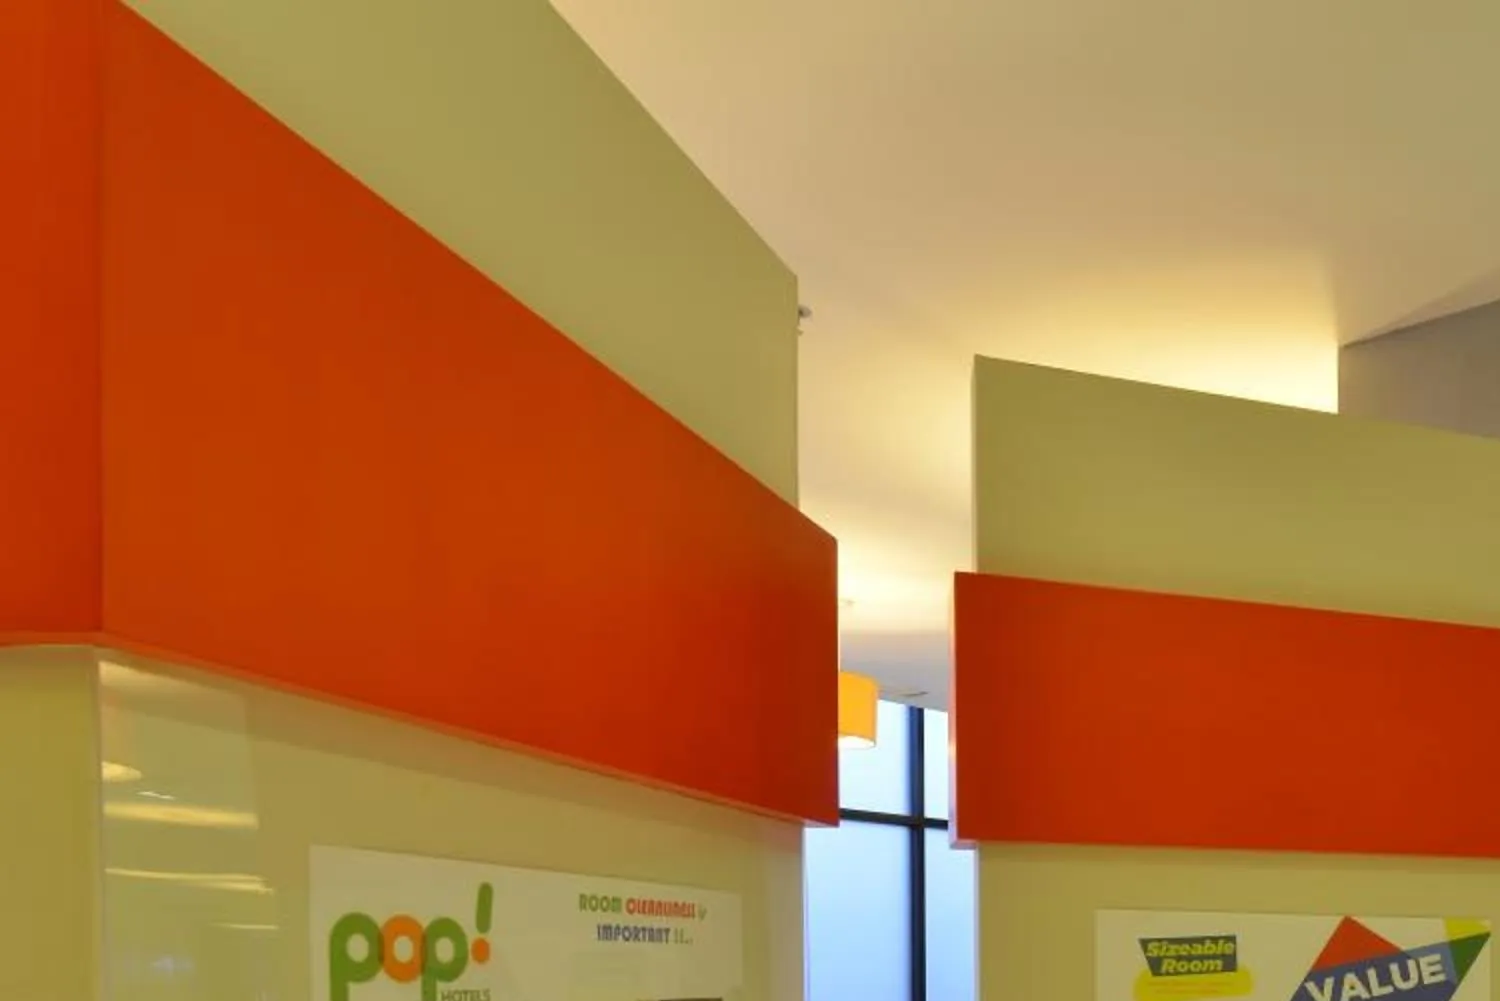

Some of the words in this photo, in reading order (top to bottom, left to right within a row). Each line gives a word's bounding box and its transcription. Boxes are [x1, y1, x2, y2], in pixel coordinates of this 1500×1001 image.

[579, 893, 622, 914] ROOM
[597, 923, 671, 944] IMPORTANT
[1145, 939, 1235, 957] Sizeable
[1160, 957, 1224, 973] Room
